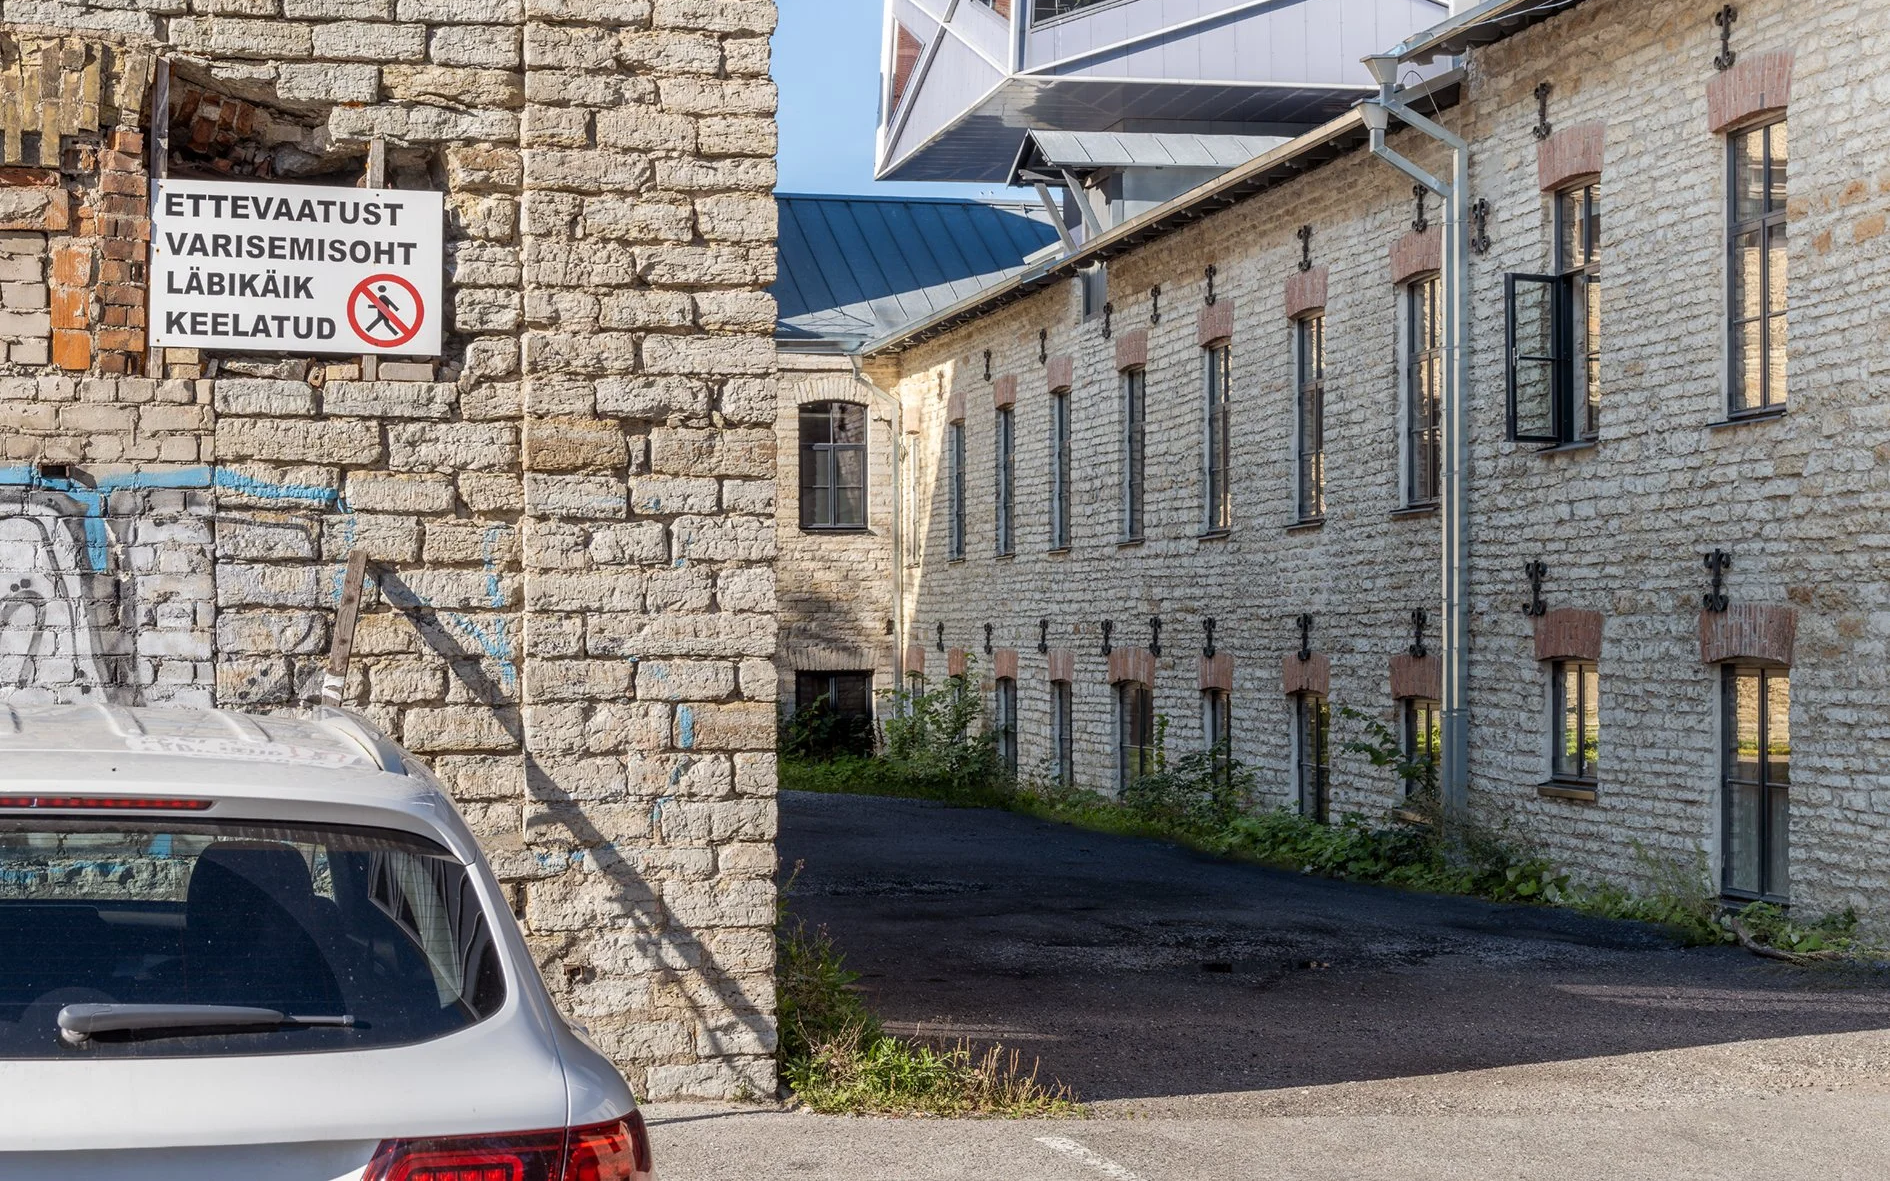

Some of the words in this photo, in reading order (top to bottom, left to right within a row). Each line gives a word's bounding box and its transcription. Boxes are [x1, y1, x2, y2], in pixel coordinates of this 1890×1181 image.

[165, 192, 404, 227] ETTEVAATUST
[165, 232, 417, 266] VARISEMISOHT
[166, 266, 314, 300] LÄBIKÄIK
[165, 311, 336, 340] KEELATUD
